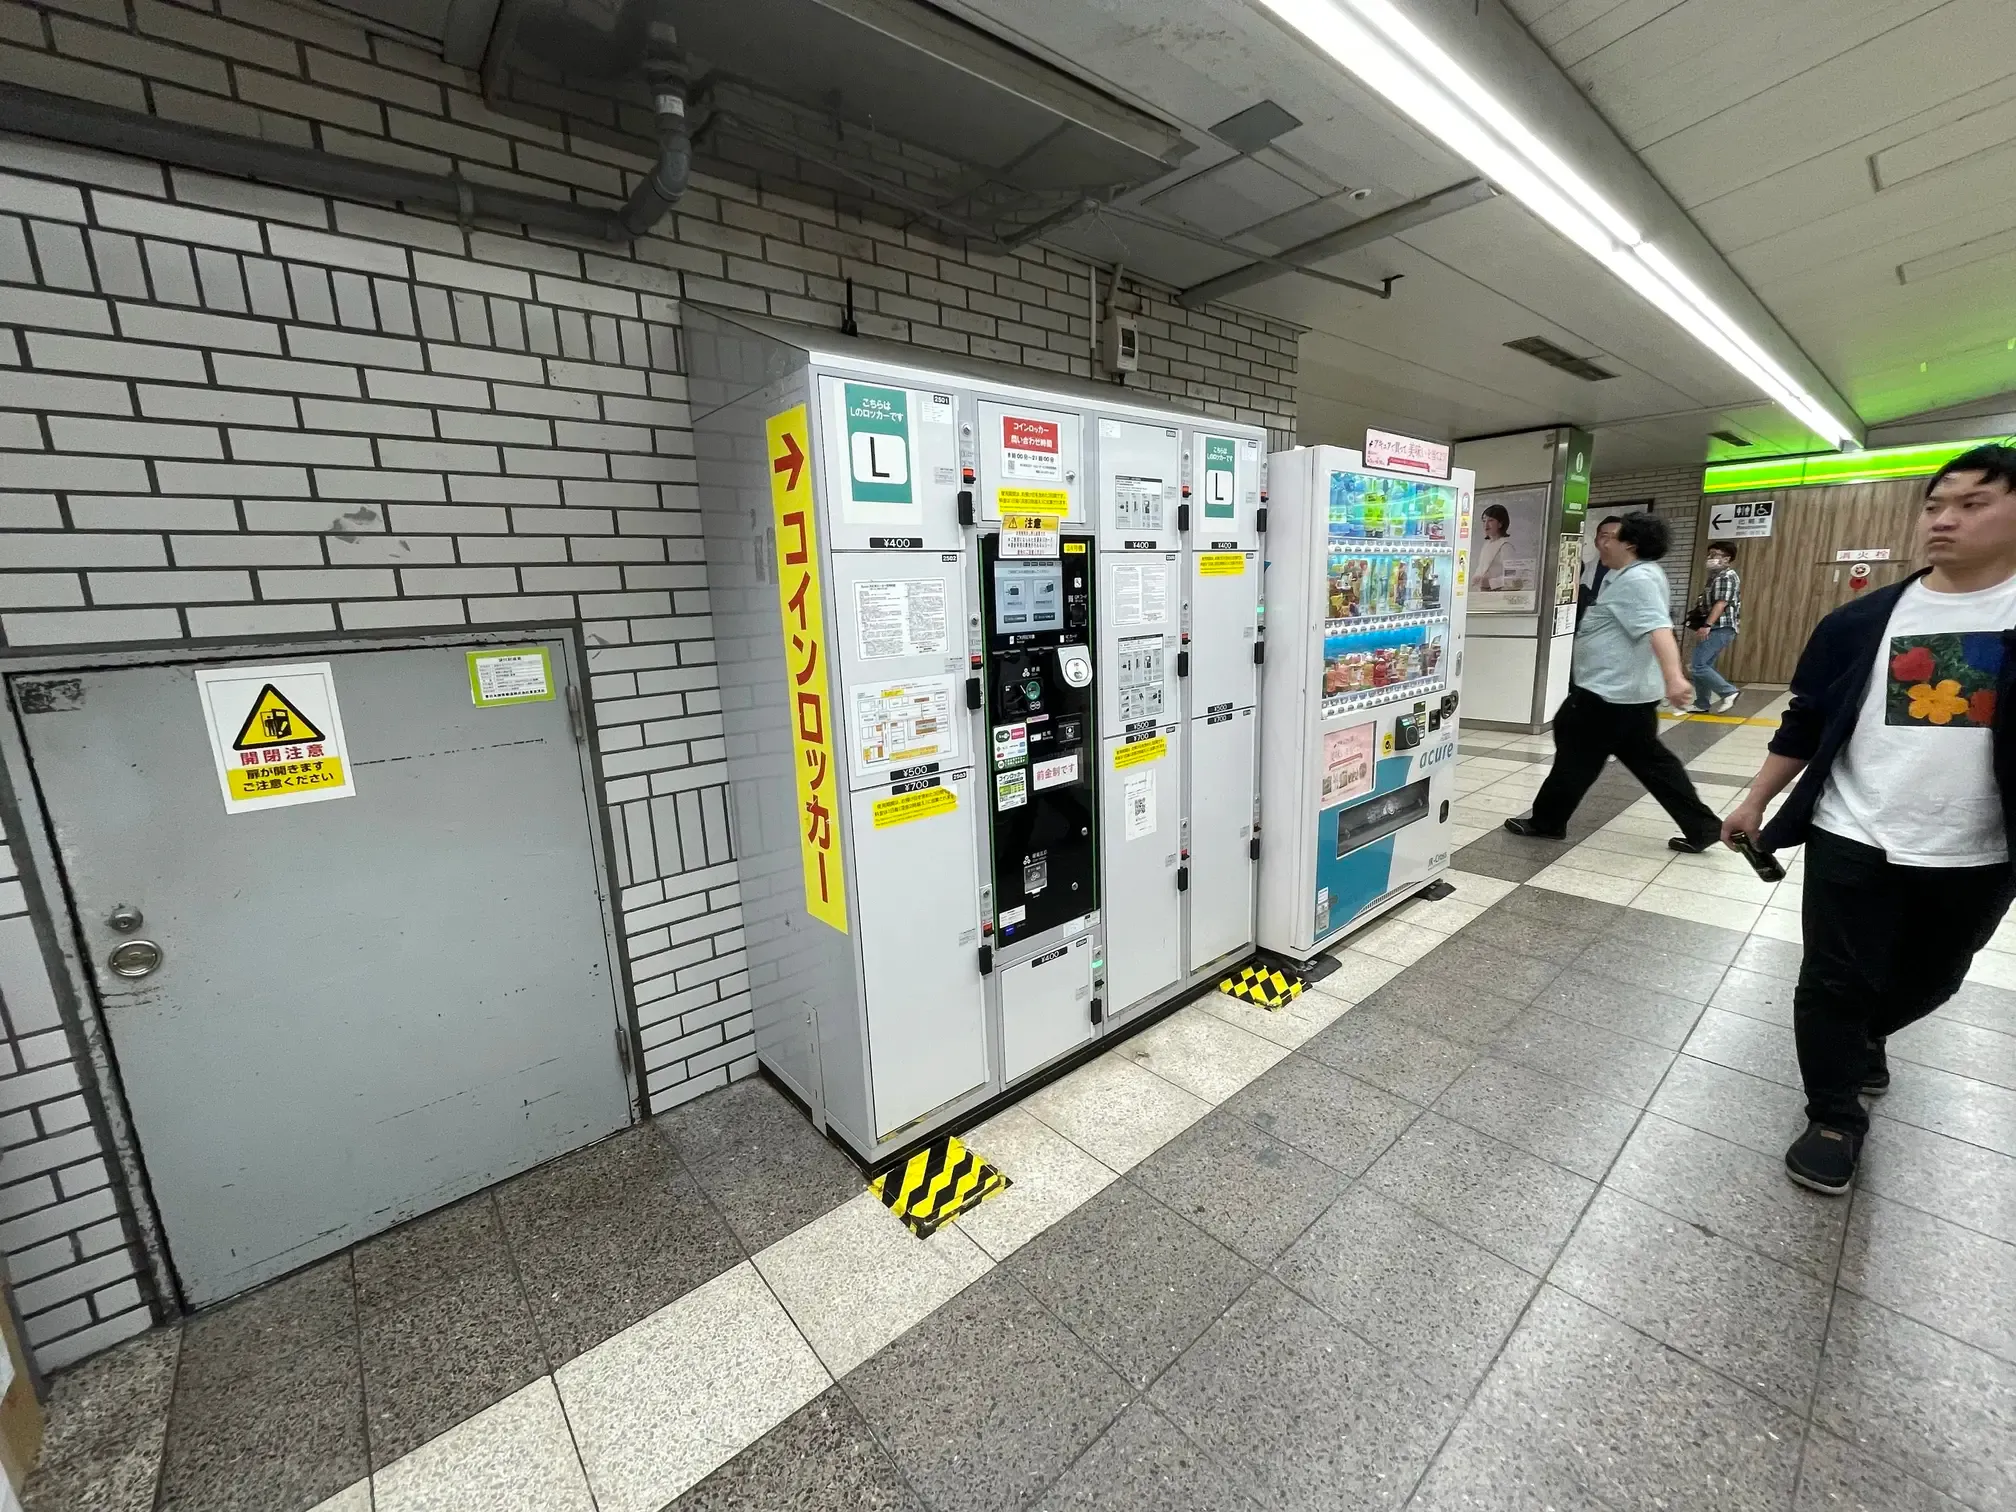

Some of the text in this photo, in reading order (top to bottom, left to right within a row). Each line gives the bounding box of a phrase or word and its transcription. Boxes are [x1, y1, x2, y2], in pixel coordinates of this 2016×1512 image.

[862, 398, 892, 411] こちらは
[850, 407, 904, 422] Lのロッカーです
[1013, 422, 1050, 435] コインロッカー
[1010, 434, 1053, 449] 問い合わせ時間
[870, 436, 890, 478] L
[1215, 472, 1225, 501] L
[1024, 517, 1042, 530] 注意
[883, 538, 910, 548] ¥400
[783, 511, 831, 904] コインロッカー
[240, 743, 325, 767] 開閉注意
[1419, 742, 1454, 769] acure
[246, 761, 324, 781] 扉が開きます
[903, 765, 928, 777] ¥500
[1036, 764, 1076, 782] 前金制です
[243, 771, 335, 792] ご注意ください
[904, 780, 929, 792] ¥700
